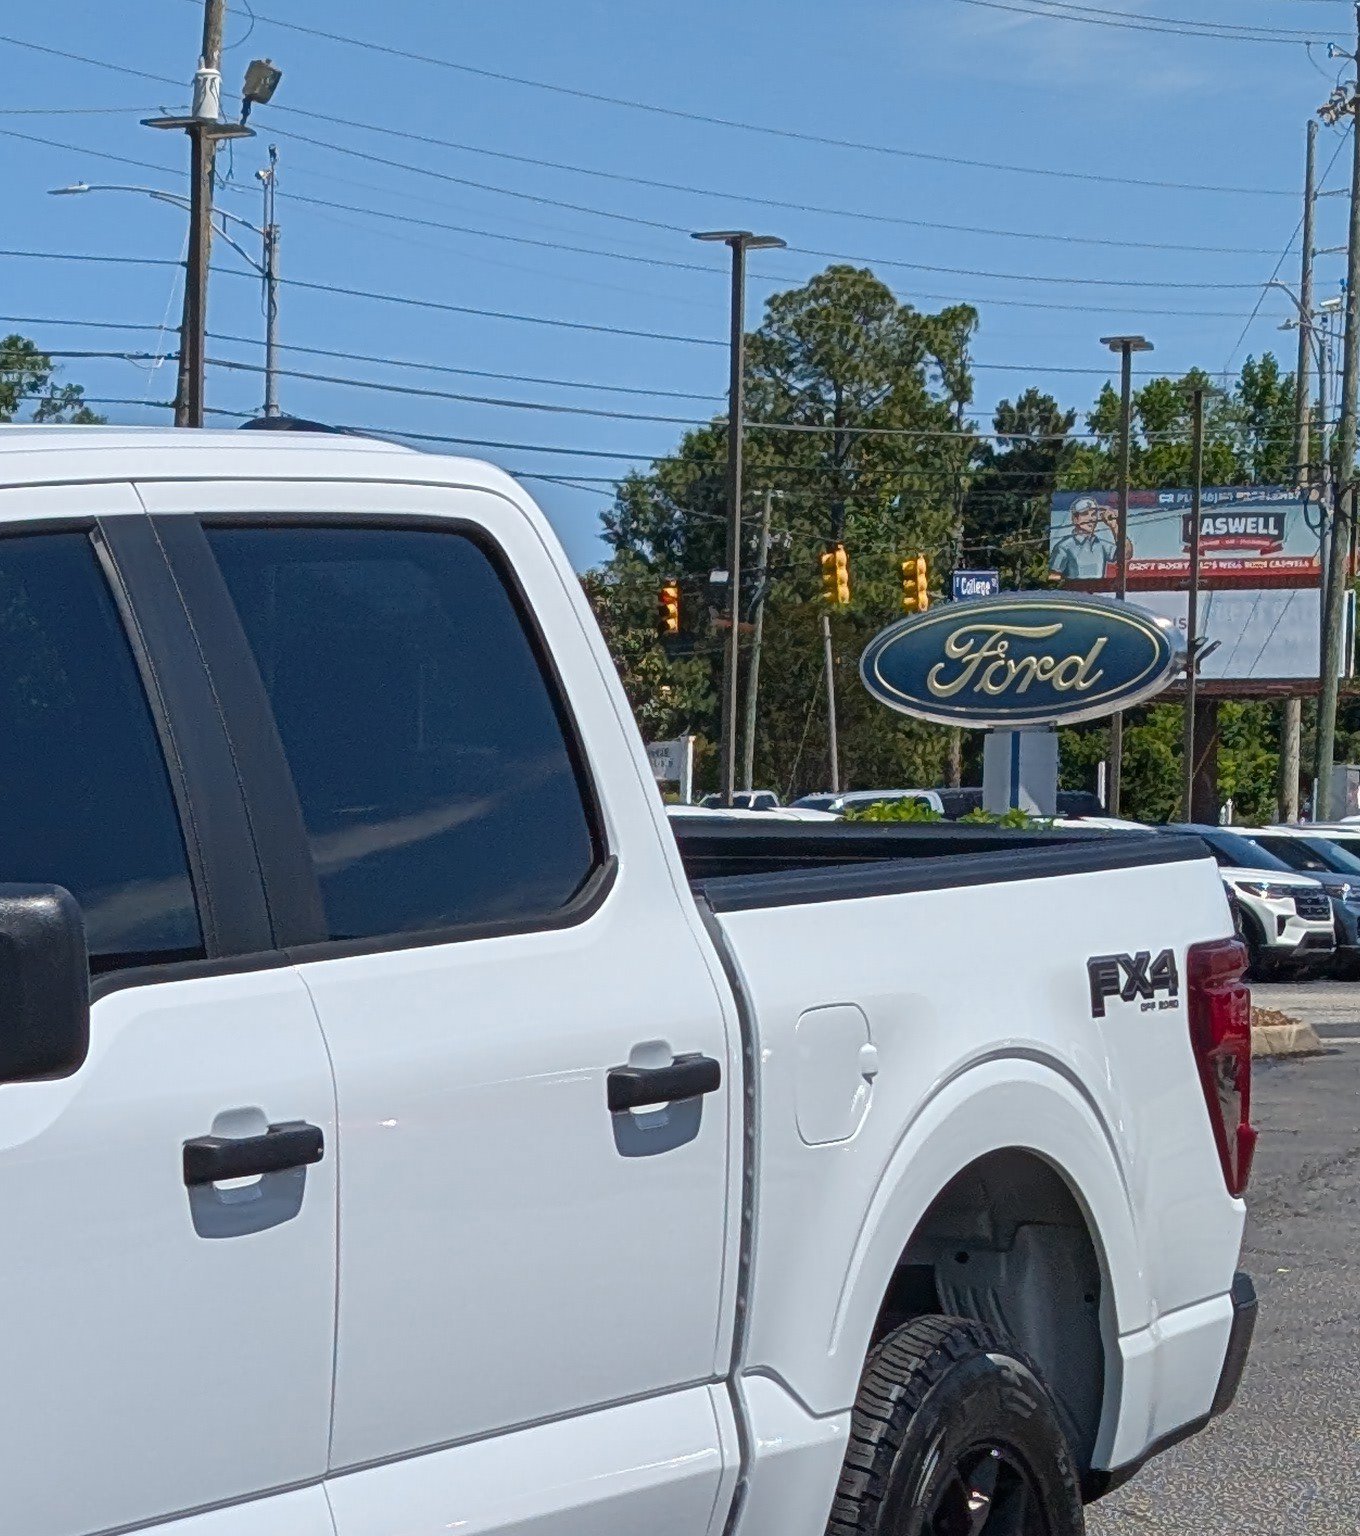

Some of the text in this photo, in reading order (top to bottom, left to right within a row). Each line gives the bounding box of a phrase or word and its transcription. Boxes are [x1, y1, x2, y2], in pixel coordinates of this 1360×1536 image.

[1188, 516, 1279, 536] ASWELL
[926, 622, 1108, 697] Ford
[1086, 948, 1179, 1018] FX4
